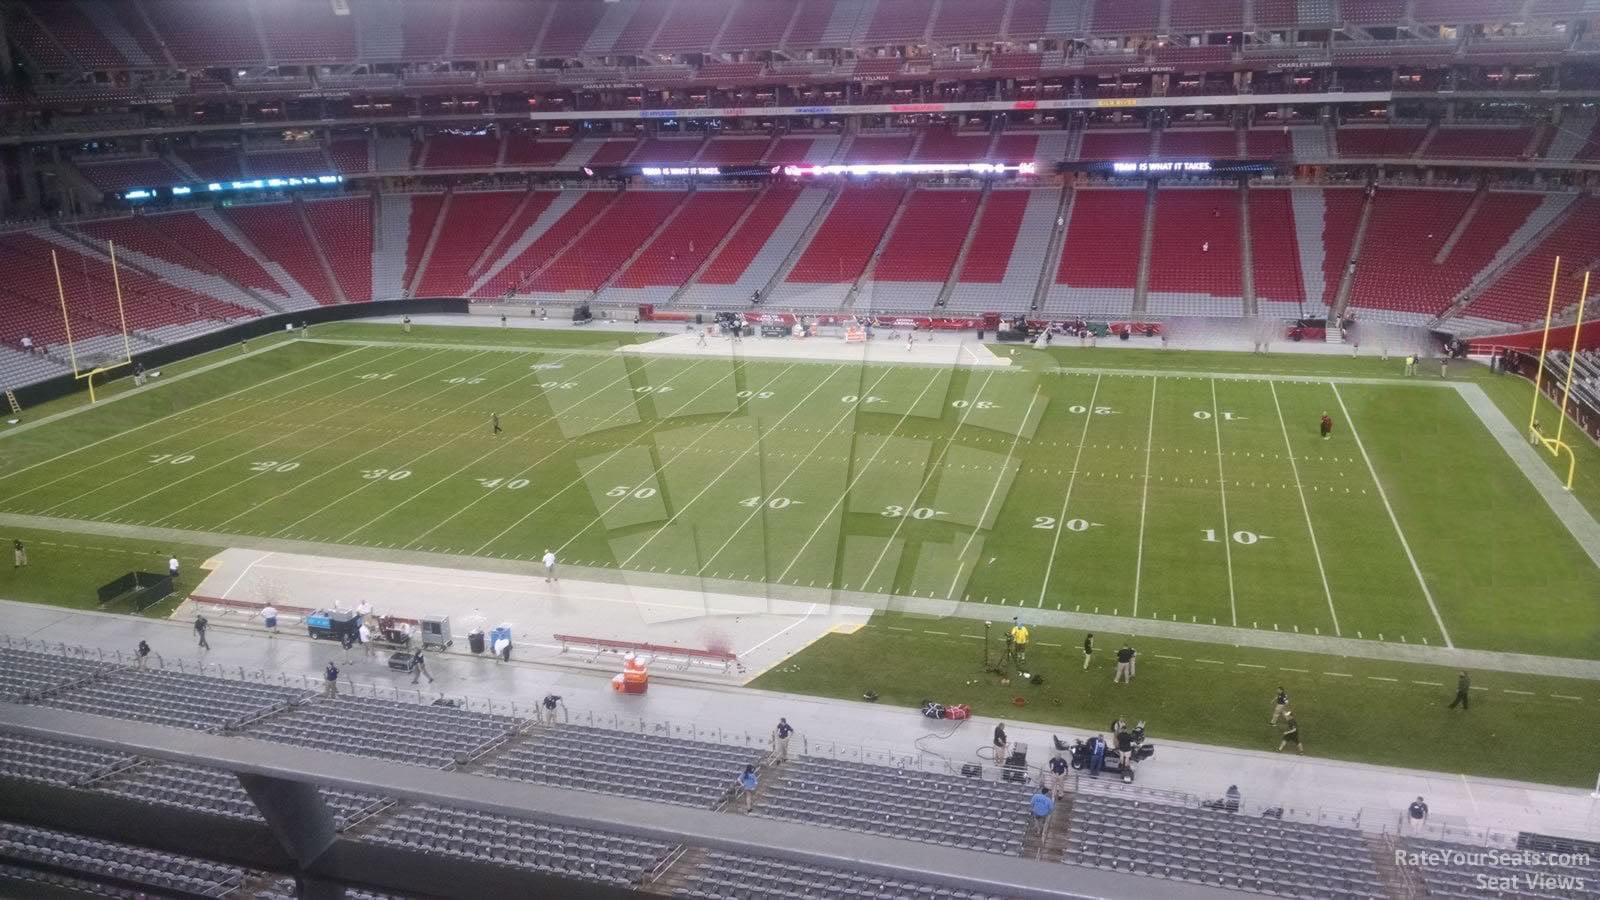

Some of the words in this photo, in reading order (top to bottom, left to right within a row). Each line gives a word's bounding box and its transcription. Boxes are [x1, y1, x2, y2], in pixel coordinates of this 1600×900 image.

[1138, 162, 1148, 171] IS
[1148, 162, 1173, 171] WHAT
[1173, 162, 1182, 170] IT
[149, 454, 195, 464] 10
[250, 461, 300, 472] 20
[361, 469, 412, 481] 30
[480, 477, 530, 489] 40
[606, 486, 657, 499] 50
[738, 496, 790, 509] 40
[881, 505, 934, 520] 30
[1031, 516, 1089, 532] 20
[1199, 529, 1258, 545] 10
